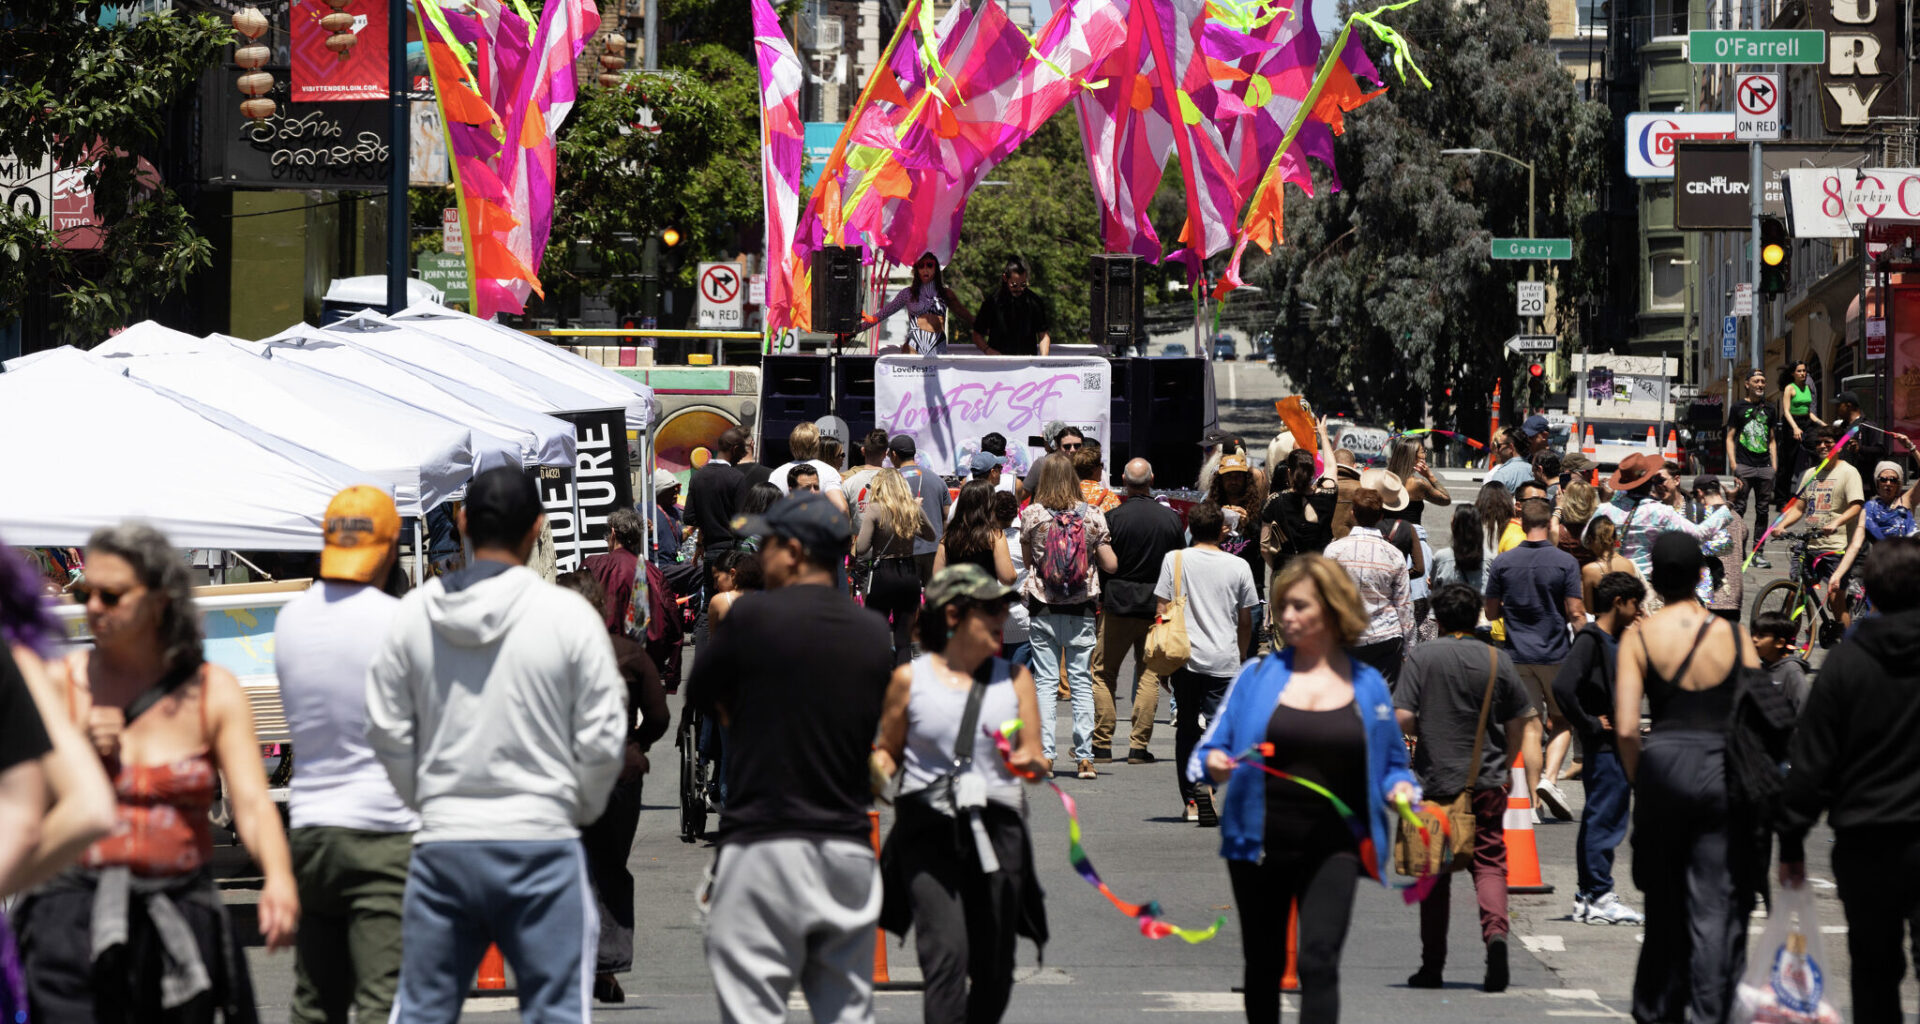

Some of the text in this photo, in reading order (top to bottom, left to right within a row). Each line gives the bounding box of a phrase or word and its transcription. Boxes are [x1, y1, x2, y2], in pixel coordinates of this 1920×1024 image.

[1715, 38, 1799, 56] O'Farrell
[301, 84, 378, 92] VISITTENDERLOIN.COM
[1739, 121, 1777, 132] ON RED
[1686, 182, 1750, 194] CENTURY
[1765, 182, 1782, 190] PR
[1847, 190, 1892, 203] larkin
[445, 210, 457, 221] NO
[1510, 243, 1553, 256] Geary
[1521, 299, 1541, 312] 20
[719, 310, 739, 320] RED
[1520, 340, 1552, 348] ONE WAY
[882, 374, 1080, 438] LoveFest SF
